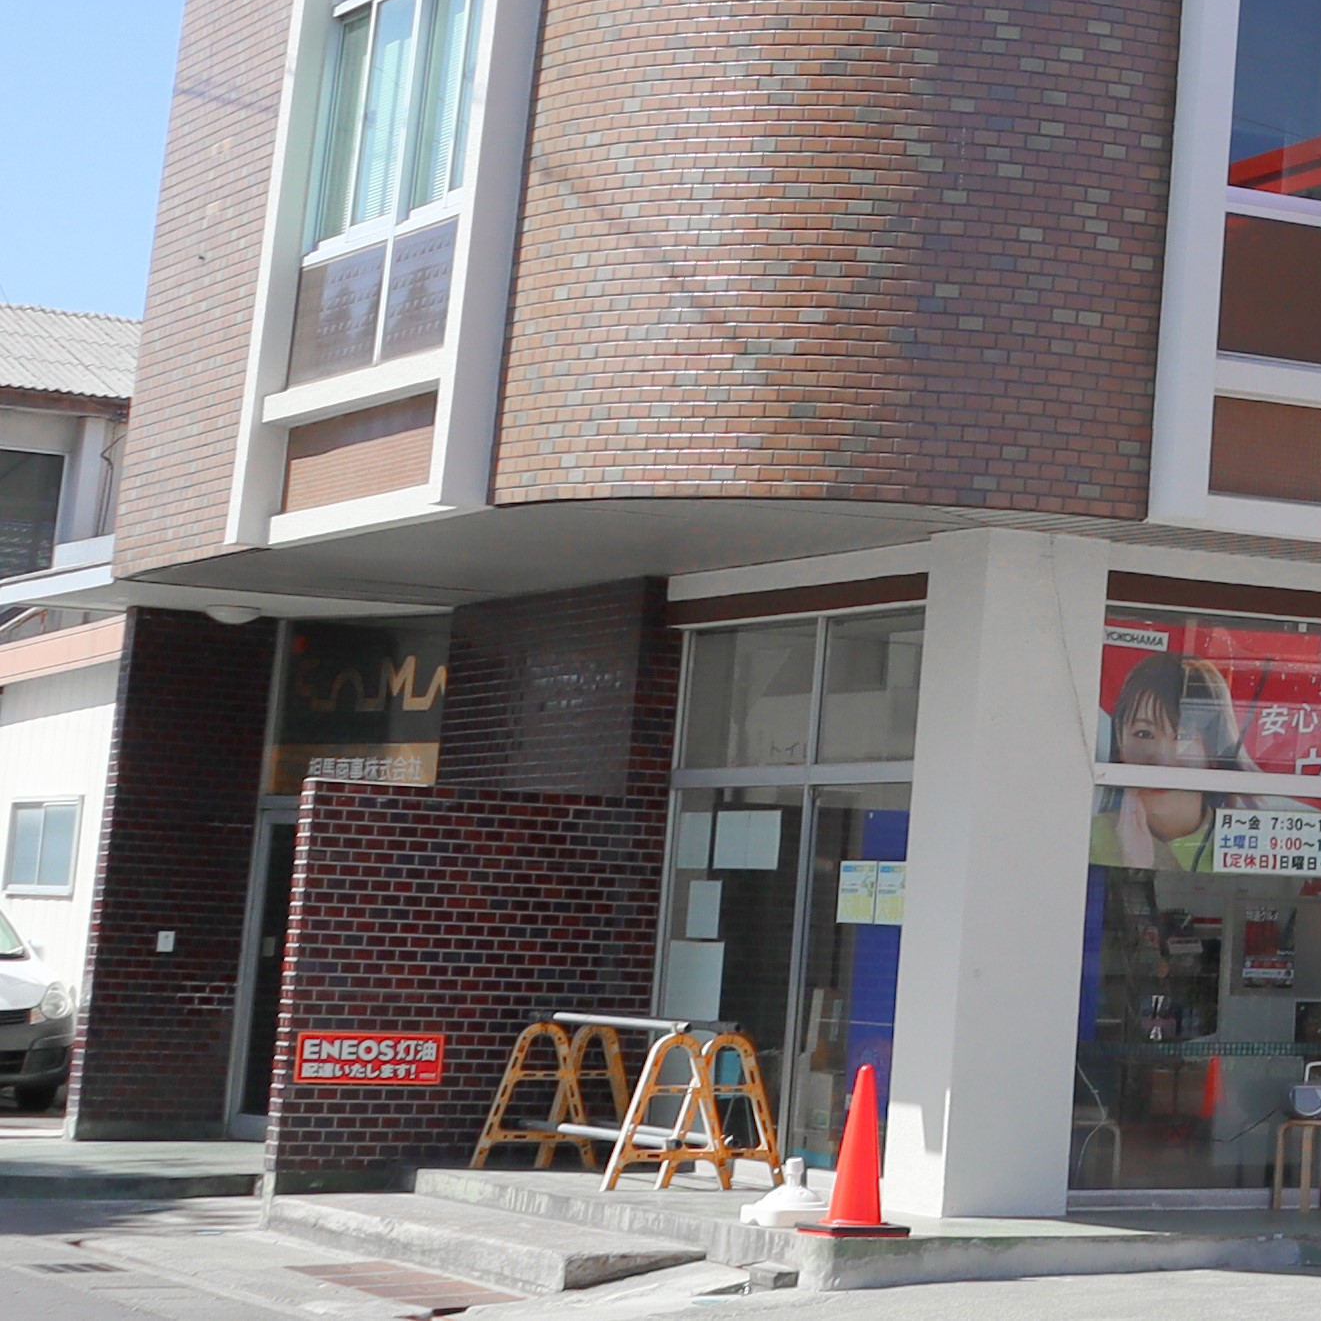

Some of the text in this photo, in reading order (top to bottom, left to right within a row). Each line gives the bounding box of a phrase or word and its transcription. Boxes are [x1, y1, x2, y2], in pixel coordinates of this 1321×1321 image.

[1104, 630, 1164, 647] YOKOHAMA
[308, 755, 424, 781] 相馬商事株式会社
[1219, 834, 1259, 850] 土曜日
[302, 1038, 438, 1063] ENEOS灯油
